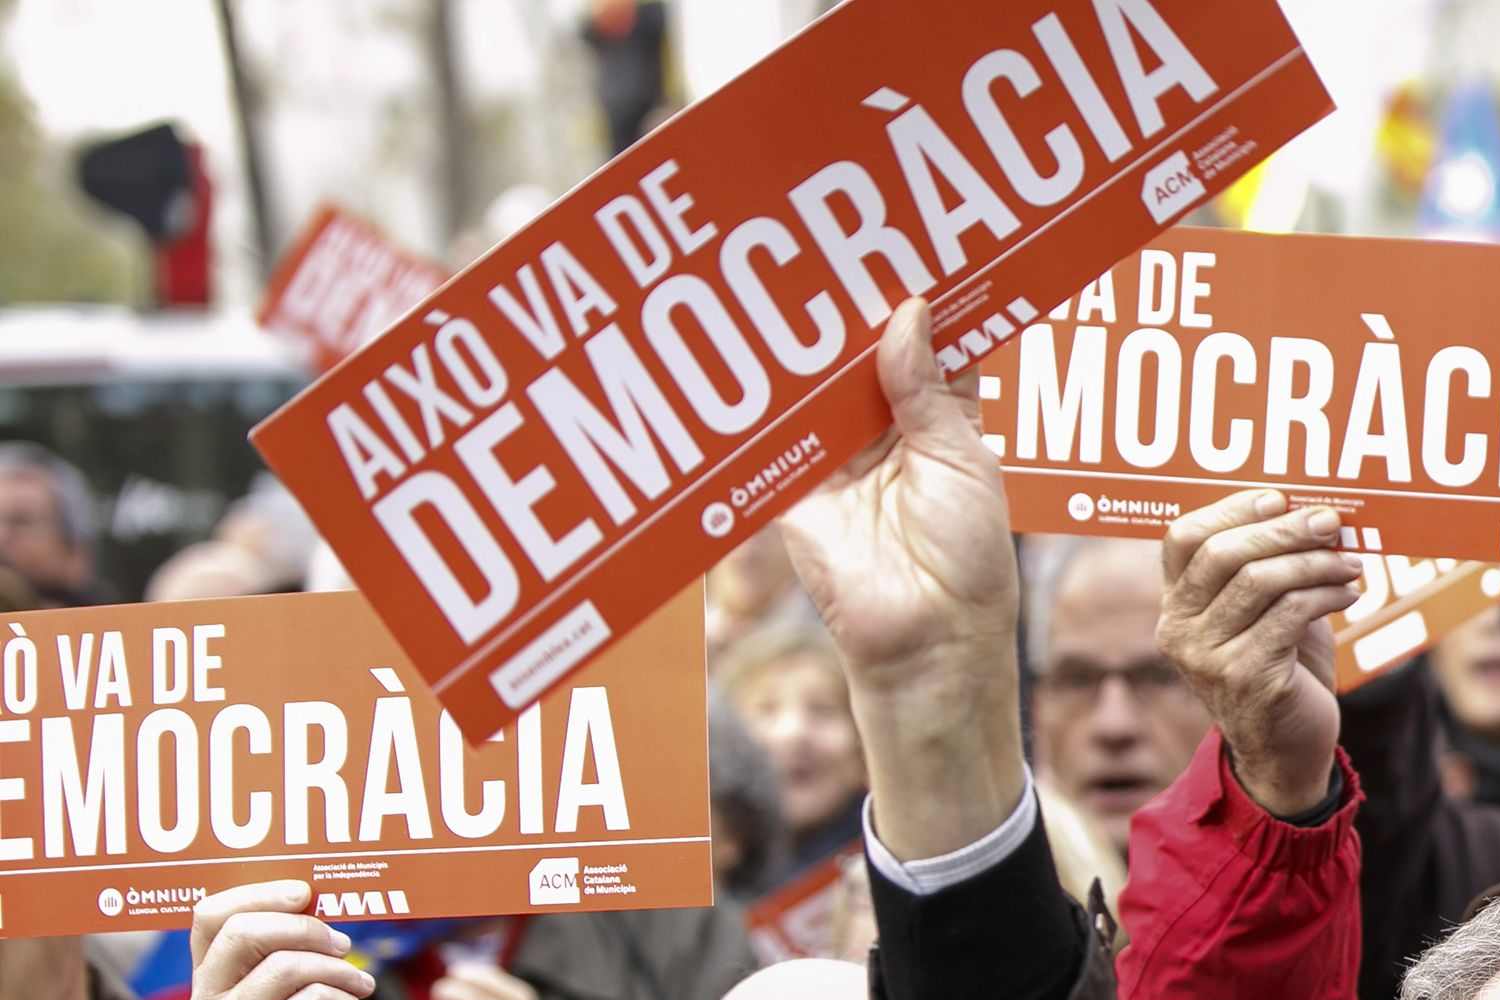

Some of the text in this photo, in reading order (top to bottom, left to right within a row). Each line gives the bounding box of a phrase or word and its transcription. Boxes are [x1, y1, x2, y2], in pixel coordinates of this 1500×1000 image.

[372, 0, 1220, 646] DEMOCRÀCIA
[1137, 248, 1217, 329] DE
[326, 309, 508, 500] AIXÒ
[489, 240, 617, 361] VA
[594, 158, 719, 283] DE
[730, 431, 821, 507] ÒMNIUM
[1097, 494, 1180, 517] ÒMNIUM
[56, 630, 133, 710] VA
[152, 623, 226, 705] DE
[126, 886, 207, 905] ÒMNIUM
[540, 873, 577, 889] ACM
